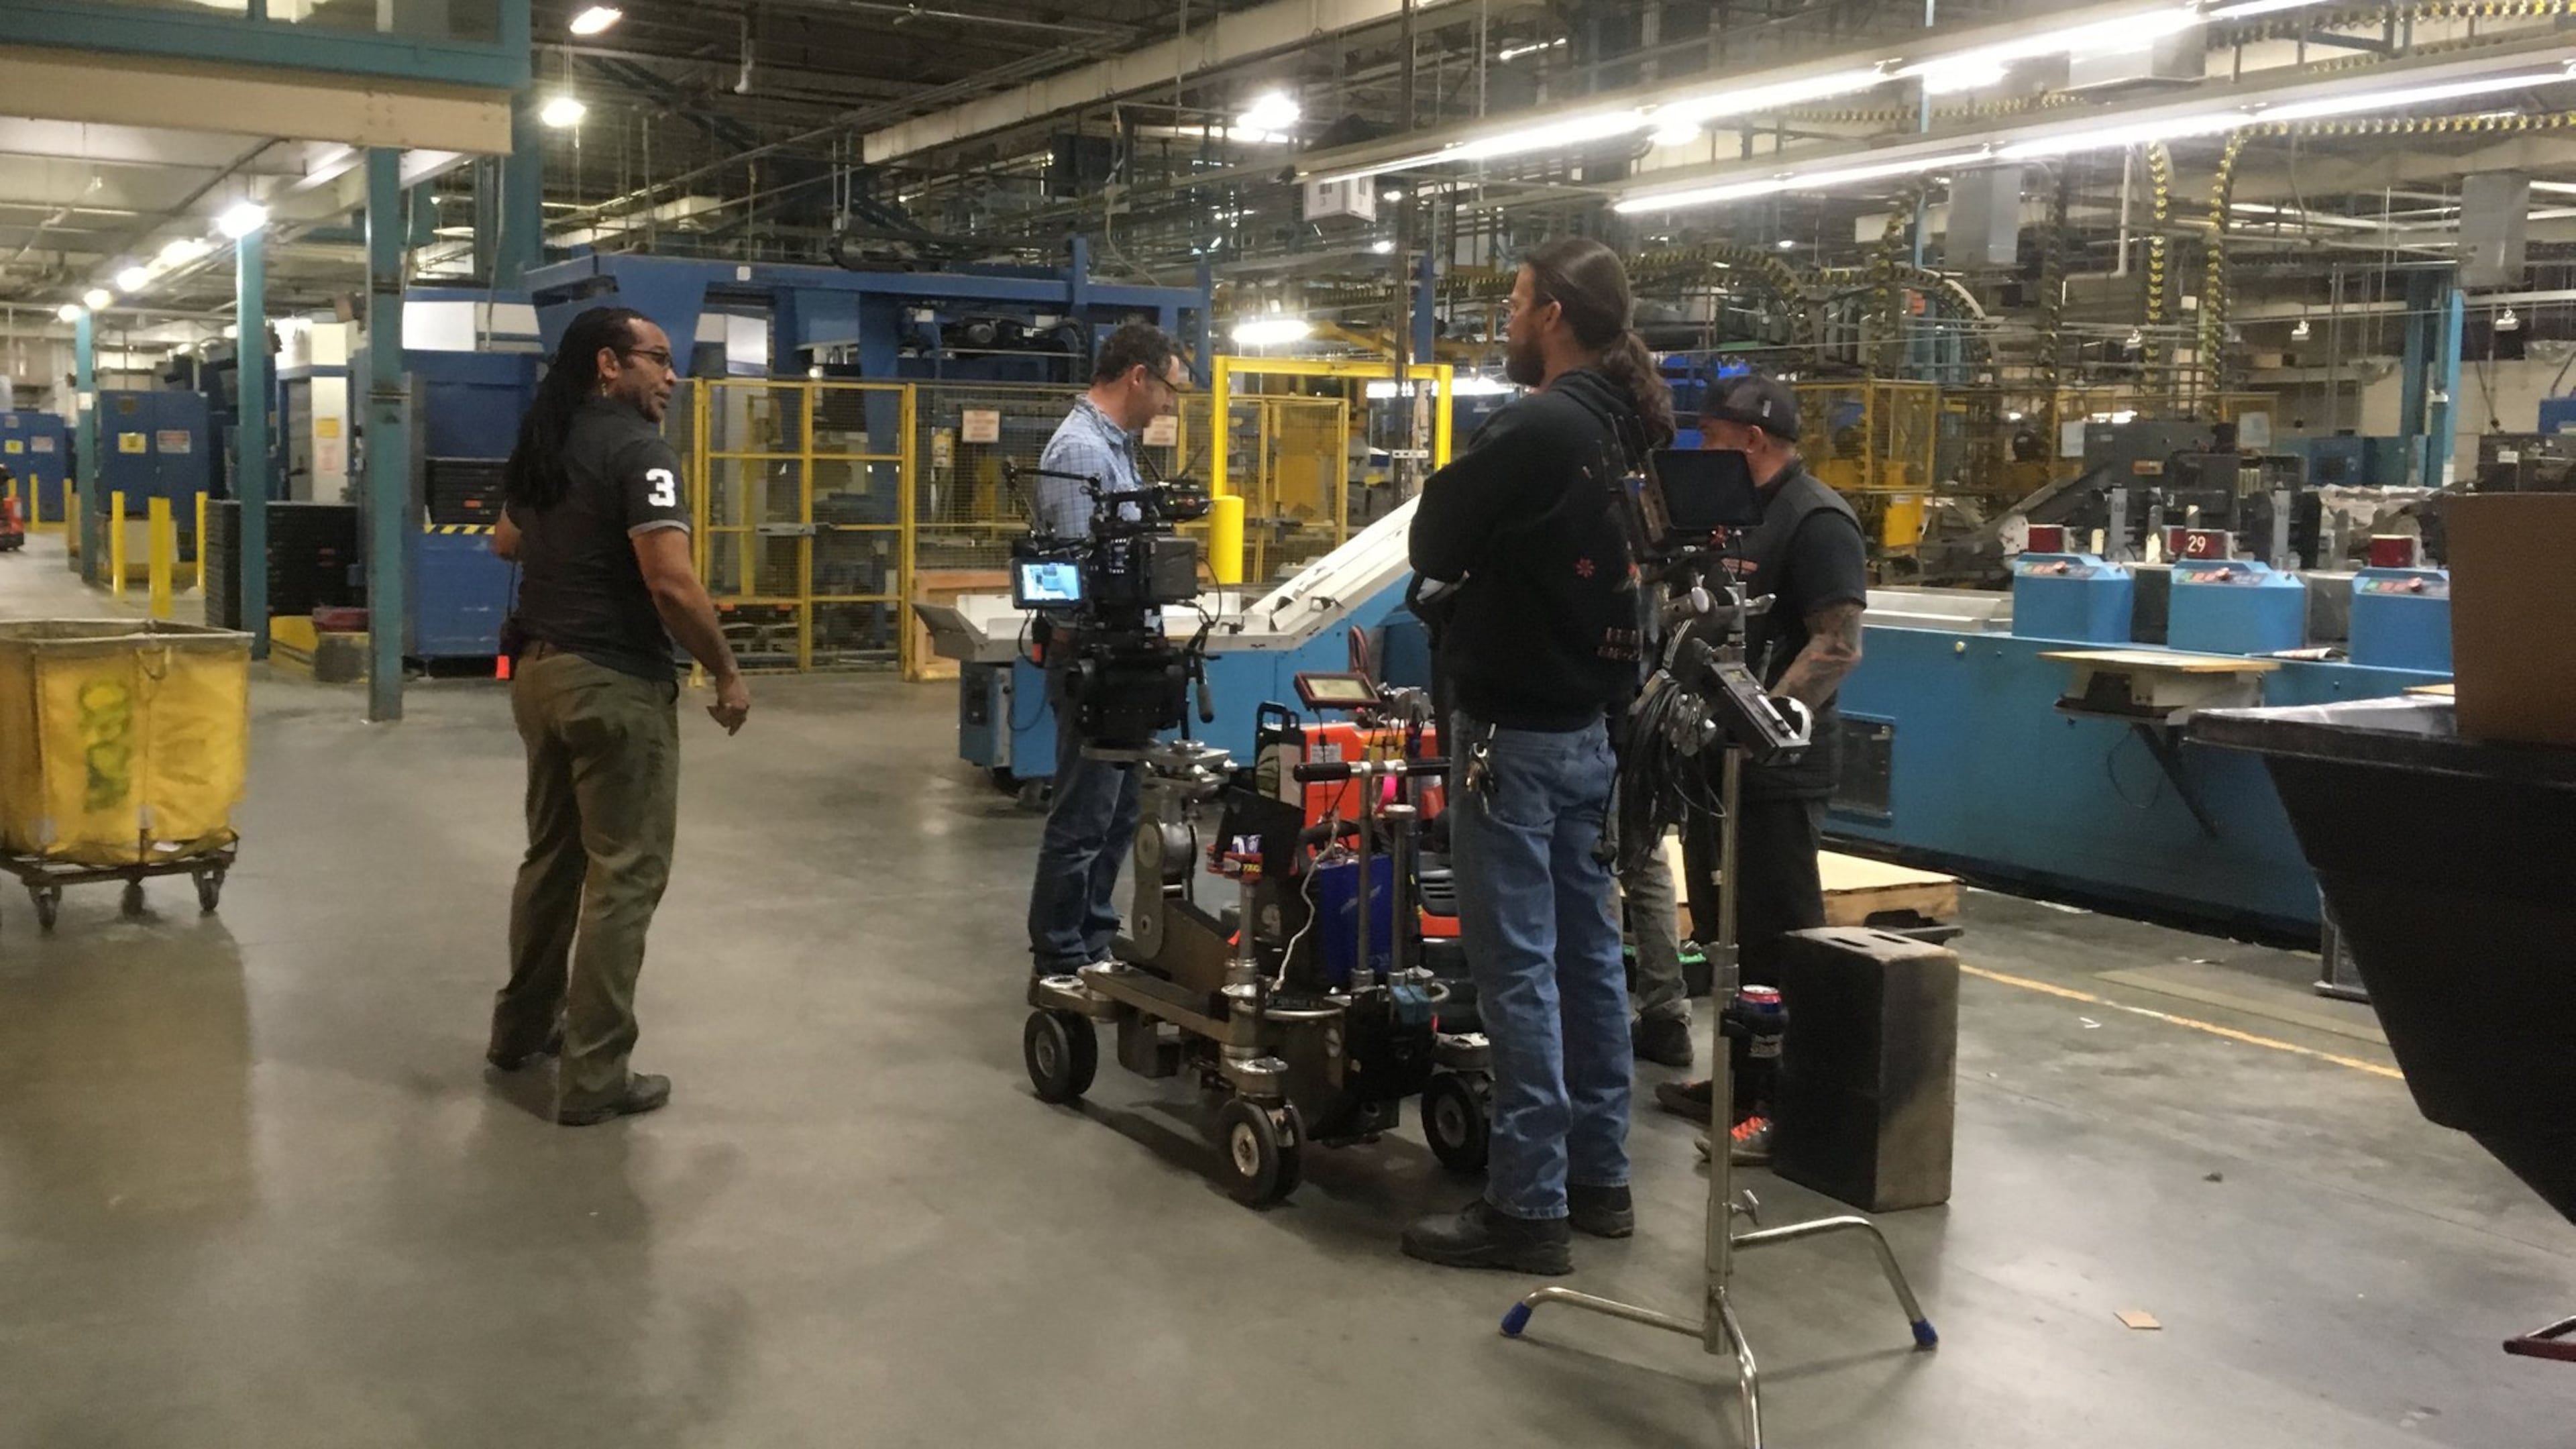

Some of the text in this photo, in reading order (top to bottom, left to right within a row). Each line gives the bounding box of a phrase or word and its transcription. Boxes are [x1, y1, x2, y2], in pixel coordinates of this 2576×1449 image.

[645, 468, 676, 508] 3
[2166, 494, 2175, 508] 3
[2187, 534, 2206, 553] 29
